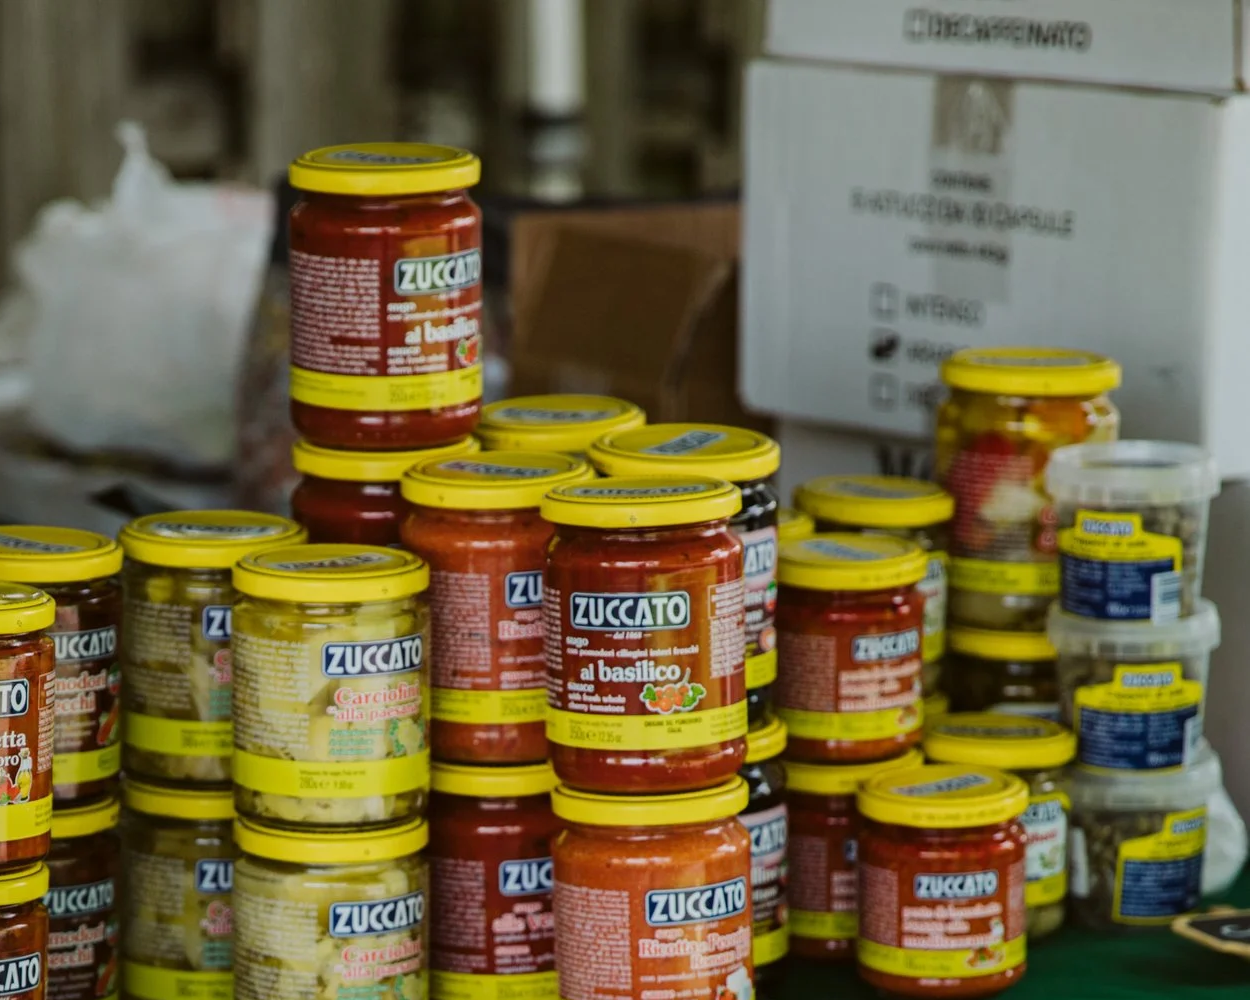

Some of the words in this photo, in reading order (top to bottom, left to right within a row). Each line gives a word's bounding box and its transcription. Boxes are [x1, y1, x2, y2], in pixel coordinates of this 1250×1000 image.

[399, 252, 480, 290] ZUCCATO
[574, 596, 687, 627] ZUCCATO
[55, 629, 116, 660] UCCATO
[327, 638, 422, 675] ZUCCATO
[580, 664, 594, 681] al
[598, 660, 681, 683] basilico
[651, 883, 746, 922] ZUCCATO
[915, 872, 997, 899] ZUCCATO
[334, 896, 425, 933] ZUCCATO
